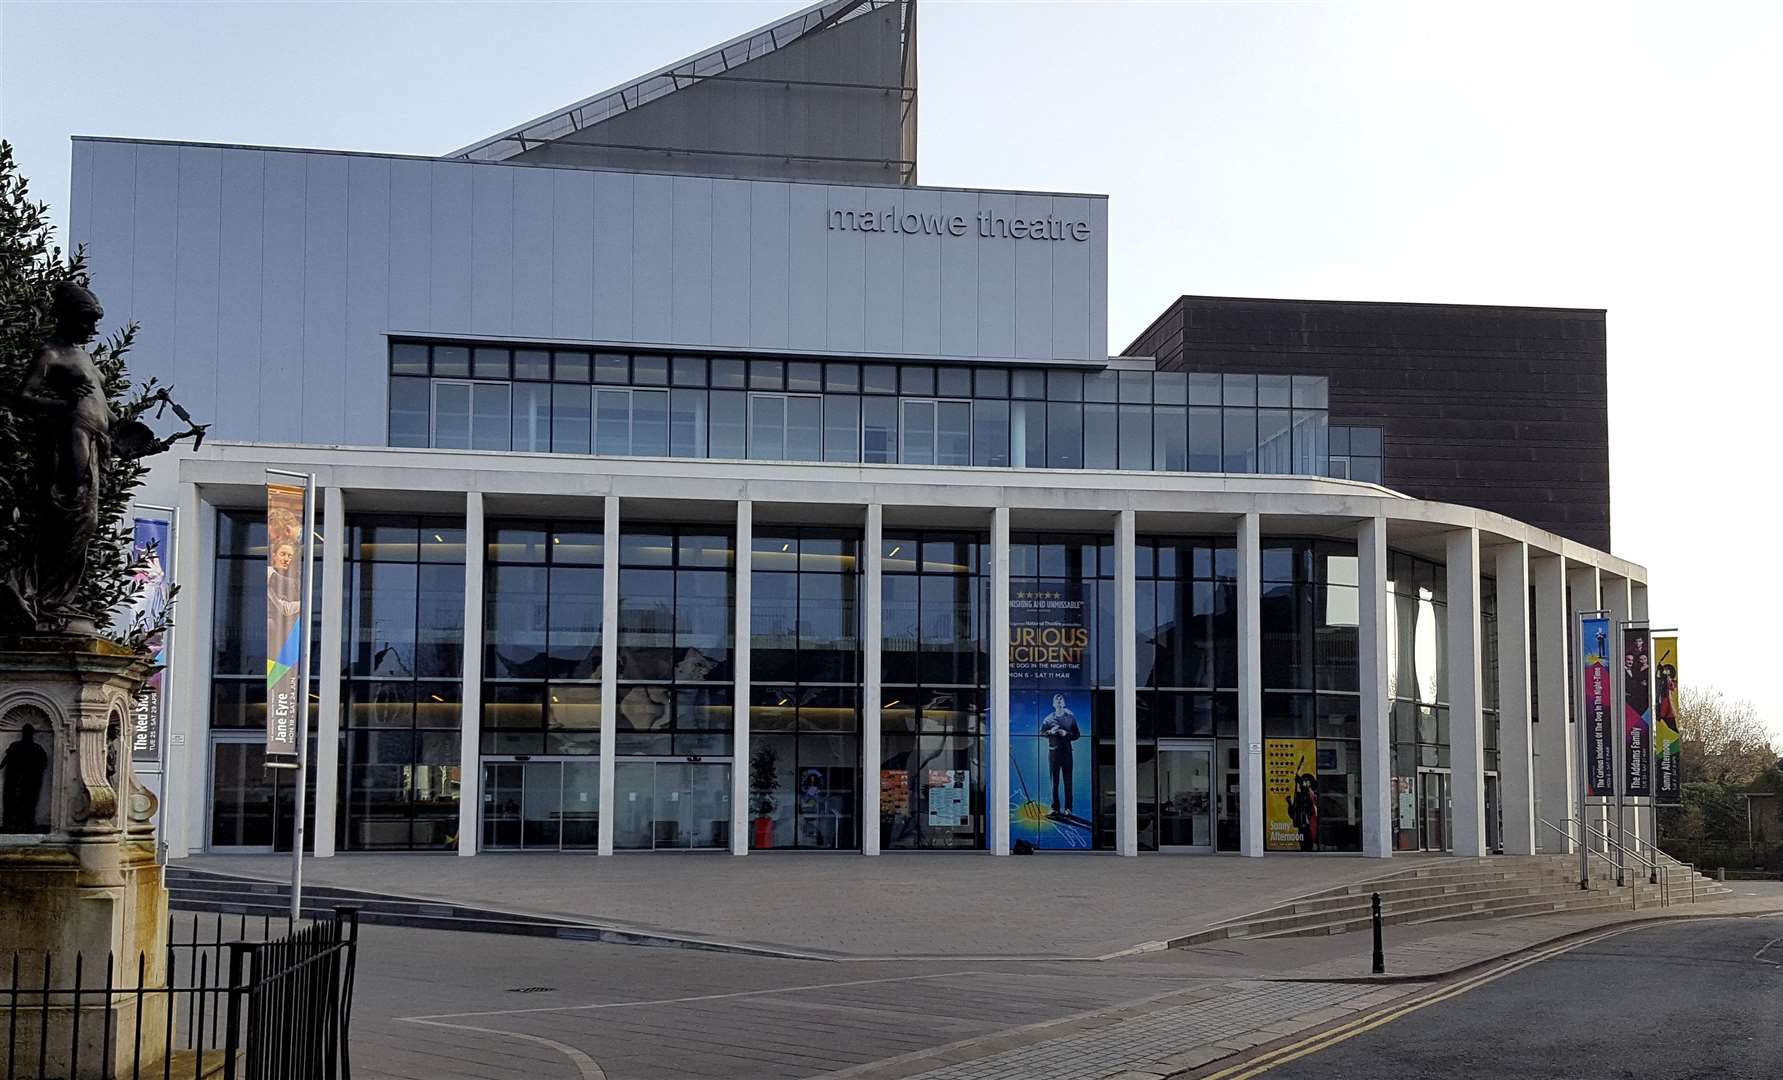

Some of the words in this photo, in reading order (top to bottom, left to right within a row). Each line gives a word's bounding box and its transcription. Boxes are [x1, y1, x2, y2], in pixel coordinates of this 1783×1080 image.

[828, 206, 967, 236] marlowe
[977, 210, 1090, 241] theatre
[1009, 628, 1088, 646] URIOUS
[275, 693, 289, 716] Eyre
[135, 714, 148, 732] Red
[1594, 712, 1603, 721] Dog
[275, 719, 287, 743] Jane
[1630, 727, 1641, 749] Family
[134, 734, 147, 751] The
[1596, 760, 1604, 778] Curious
[1631, 750, 1640, 776] Addams
[1597, 779, 1605, 788] The
[1631, 777, 1640, 789] The
[1661, 772, 1672, 791] Sunny
[1270, 821, 1290, 831] Sunny
[1270, 831, 1304, 841] Afternoon
